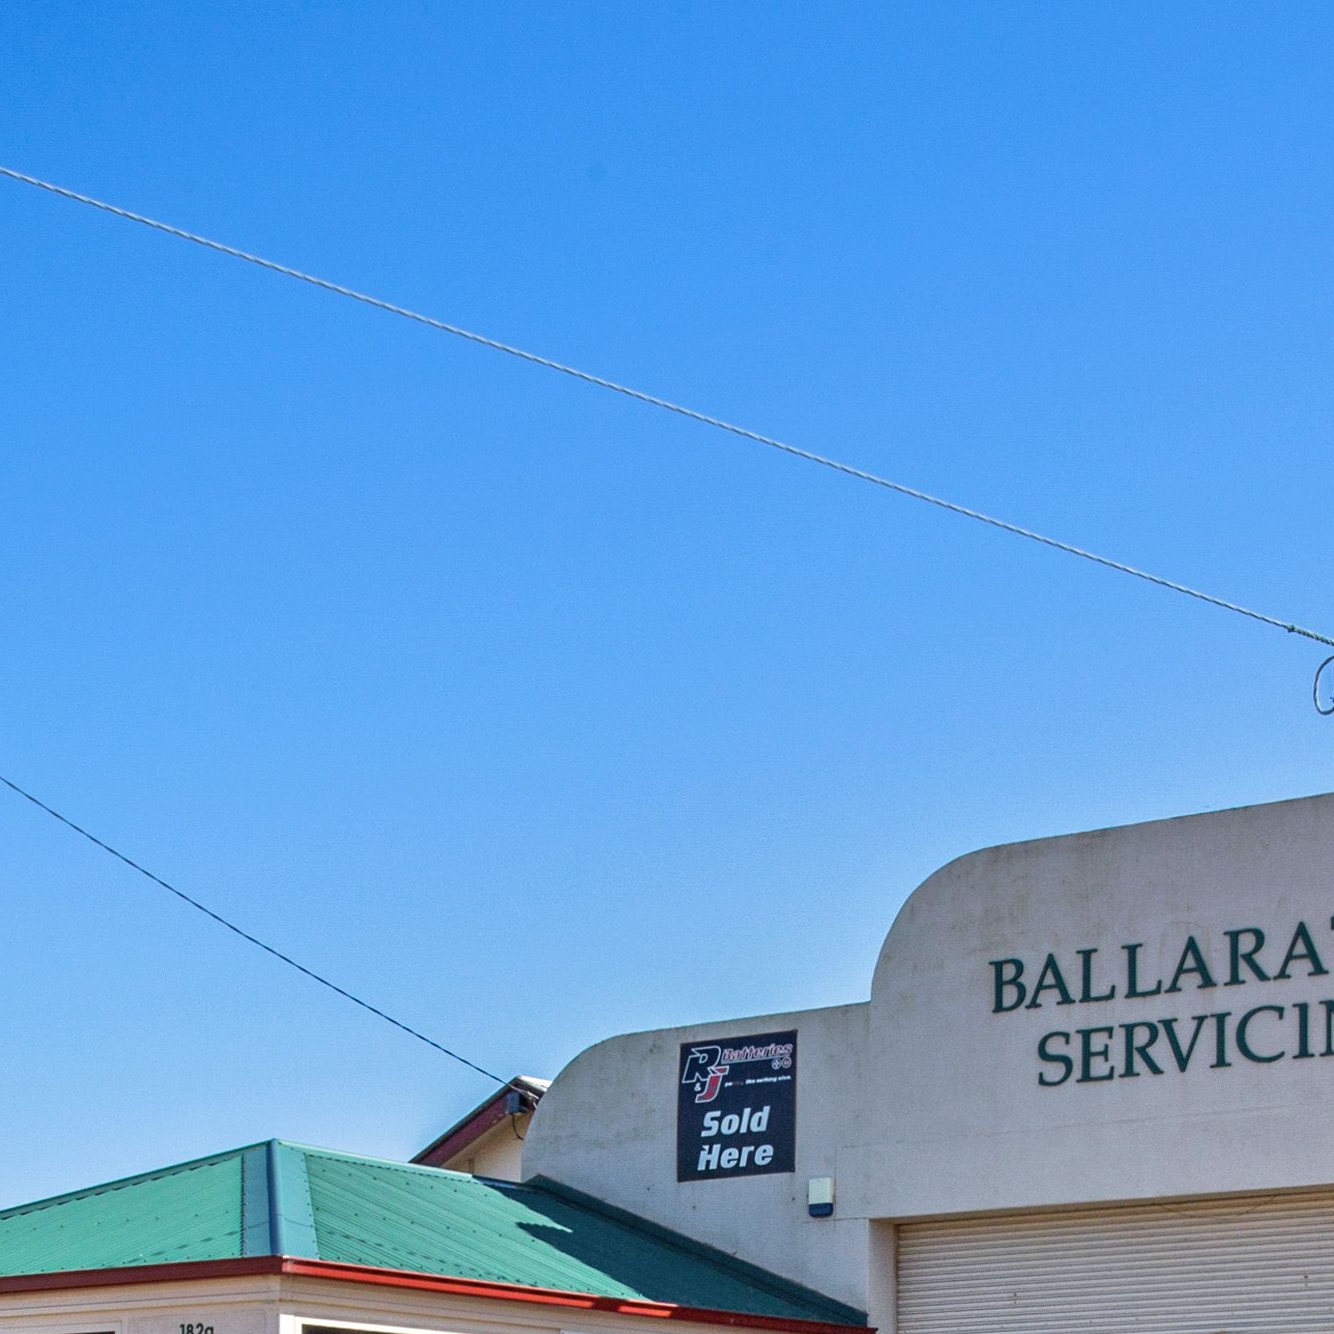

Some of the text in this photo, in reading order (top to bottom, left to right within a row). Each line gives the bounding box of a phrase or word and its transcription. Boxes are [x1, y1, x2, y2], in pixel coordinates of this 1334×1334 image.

[721, 1043, 793, 1062] Batteries
[701, 1106, 771, 1137] Sold
[697, 1144, 773, 1171] Here
